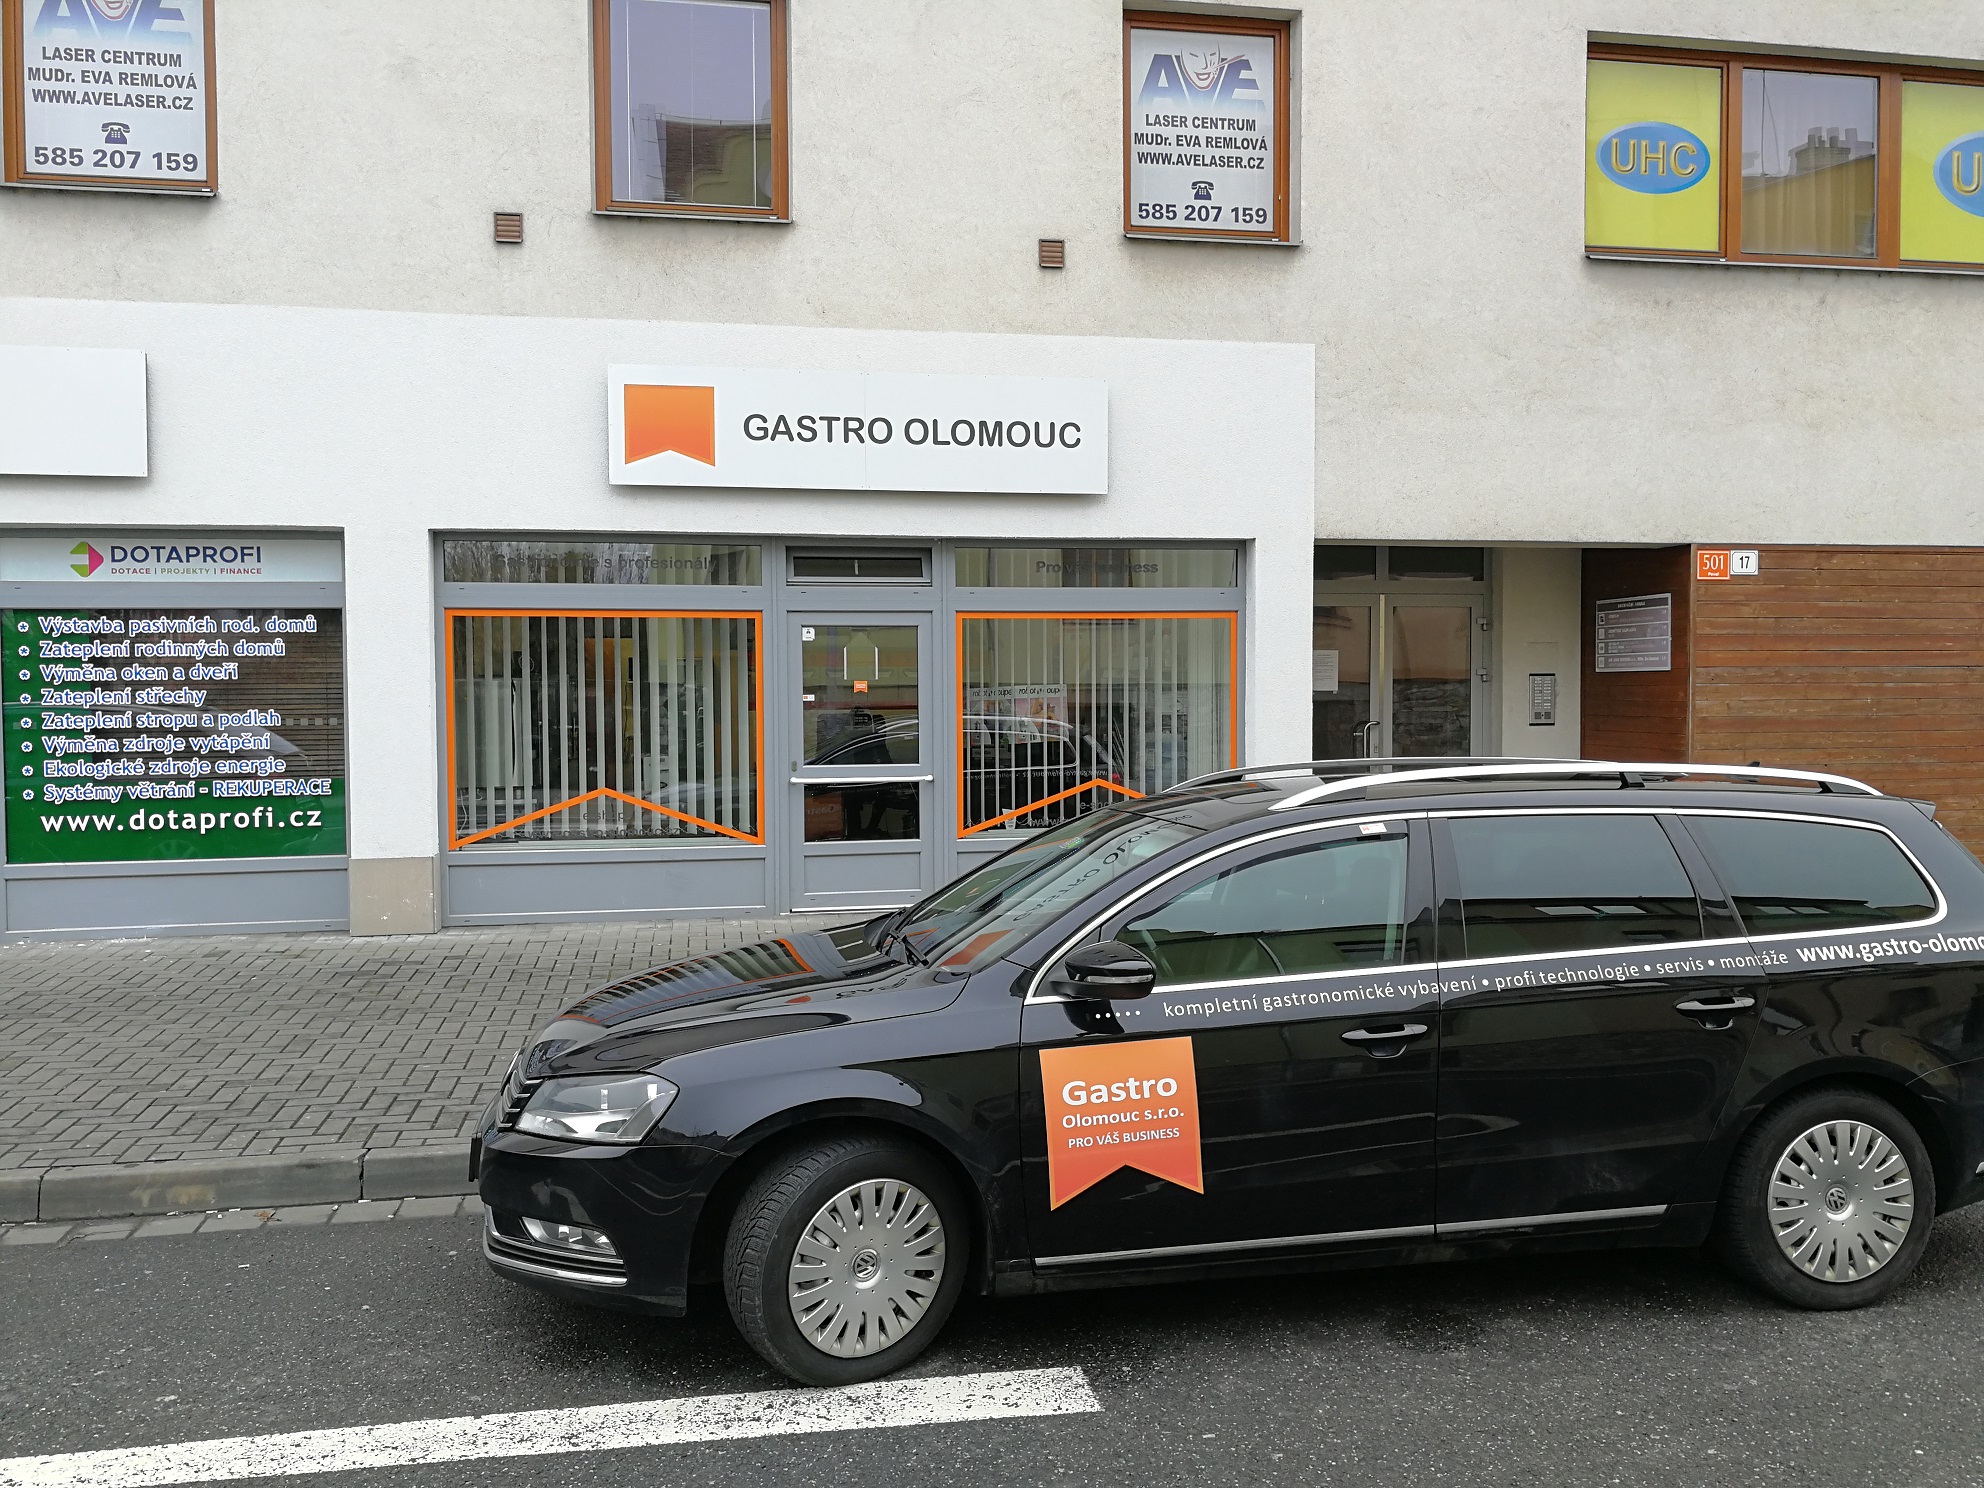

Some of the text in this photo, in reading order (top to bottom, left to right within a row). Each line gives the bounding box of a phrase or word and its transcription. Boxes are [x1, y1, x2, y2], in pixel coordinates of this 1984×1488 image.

[42, 46, 182, 67] LASER CENTRUM
[28, 67, 197, 90] MUDr. EVA REMLOVÁ
[32, 89, 194, 110] WWW.AVELASER.CZ
[1145, 114, 1256, 132] LASER CENTRUM
[1134, 133, 1268, 151] MUDr. EVA REMLOVÁ
[34, 146, 198, 172] 585 207 159
[1137, 152, 1265, 170] WWW.AVELASER.CZ
[1610, 137, 1697, 177] UHC
[1138, 203, 1268, 224] 585 207 159
[742, 413, 1082, 449] GASTRO OLOMOUC
[110, 546, 262, 564] DOTAPROFI
[617, 555, 718, 573] profesionály
[1702, 554, 1725, 570] 501
[1739, 555, 1750, 569] 17
[1035, 561, 1061, 573] Pro
[39, 615, 317, 635] Výstavba pasivních rod. domů
[40, 639, 285, 659] Zateplení rodinných domů
[40, 663, 238, 683] Výměna oken a dveří
[41, 687, 207, 707] Zateplení střechy
[42, 709, 281, 731] Zateplení stropu a podlah
[43, 733, 271, 754] Výměna zdroje vytápění
[44, 757, 286, 778] Ekologické zdroje energie
[44, 782, 122, 803] Systémy
[127, 781, 196, 799] větrání
[213, 779, 332, 797] REKUPERACE
[40, 806, 322, 833] www.dotaprofi.cz
[1163, 993, 1259, 1018] kompletní
[1262, 982, 1394, 1012] gastronomické
[1398, 974, 1477, 999] vybavení
[1494, 970, 1536, 992] profi
[1539, 961, 1640, 986] technologie
[1656, 955, 1704, 975] servis
[1719, 950, 1789, 971] montáže
[1062, 1075, 1178, 1106] Gastro
[1062, 1107, 1184, 1129] Olomouc s.r.o.
[1068, 1128, 1180, 1148] PRO VÁŠ BUSINESS
